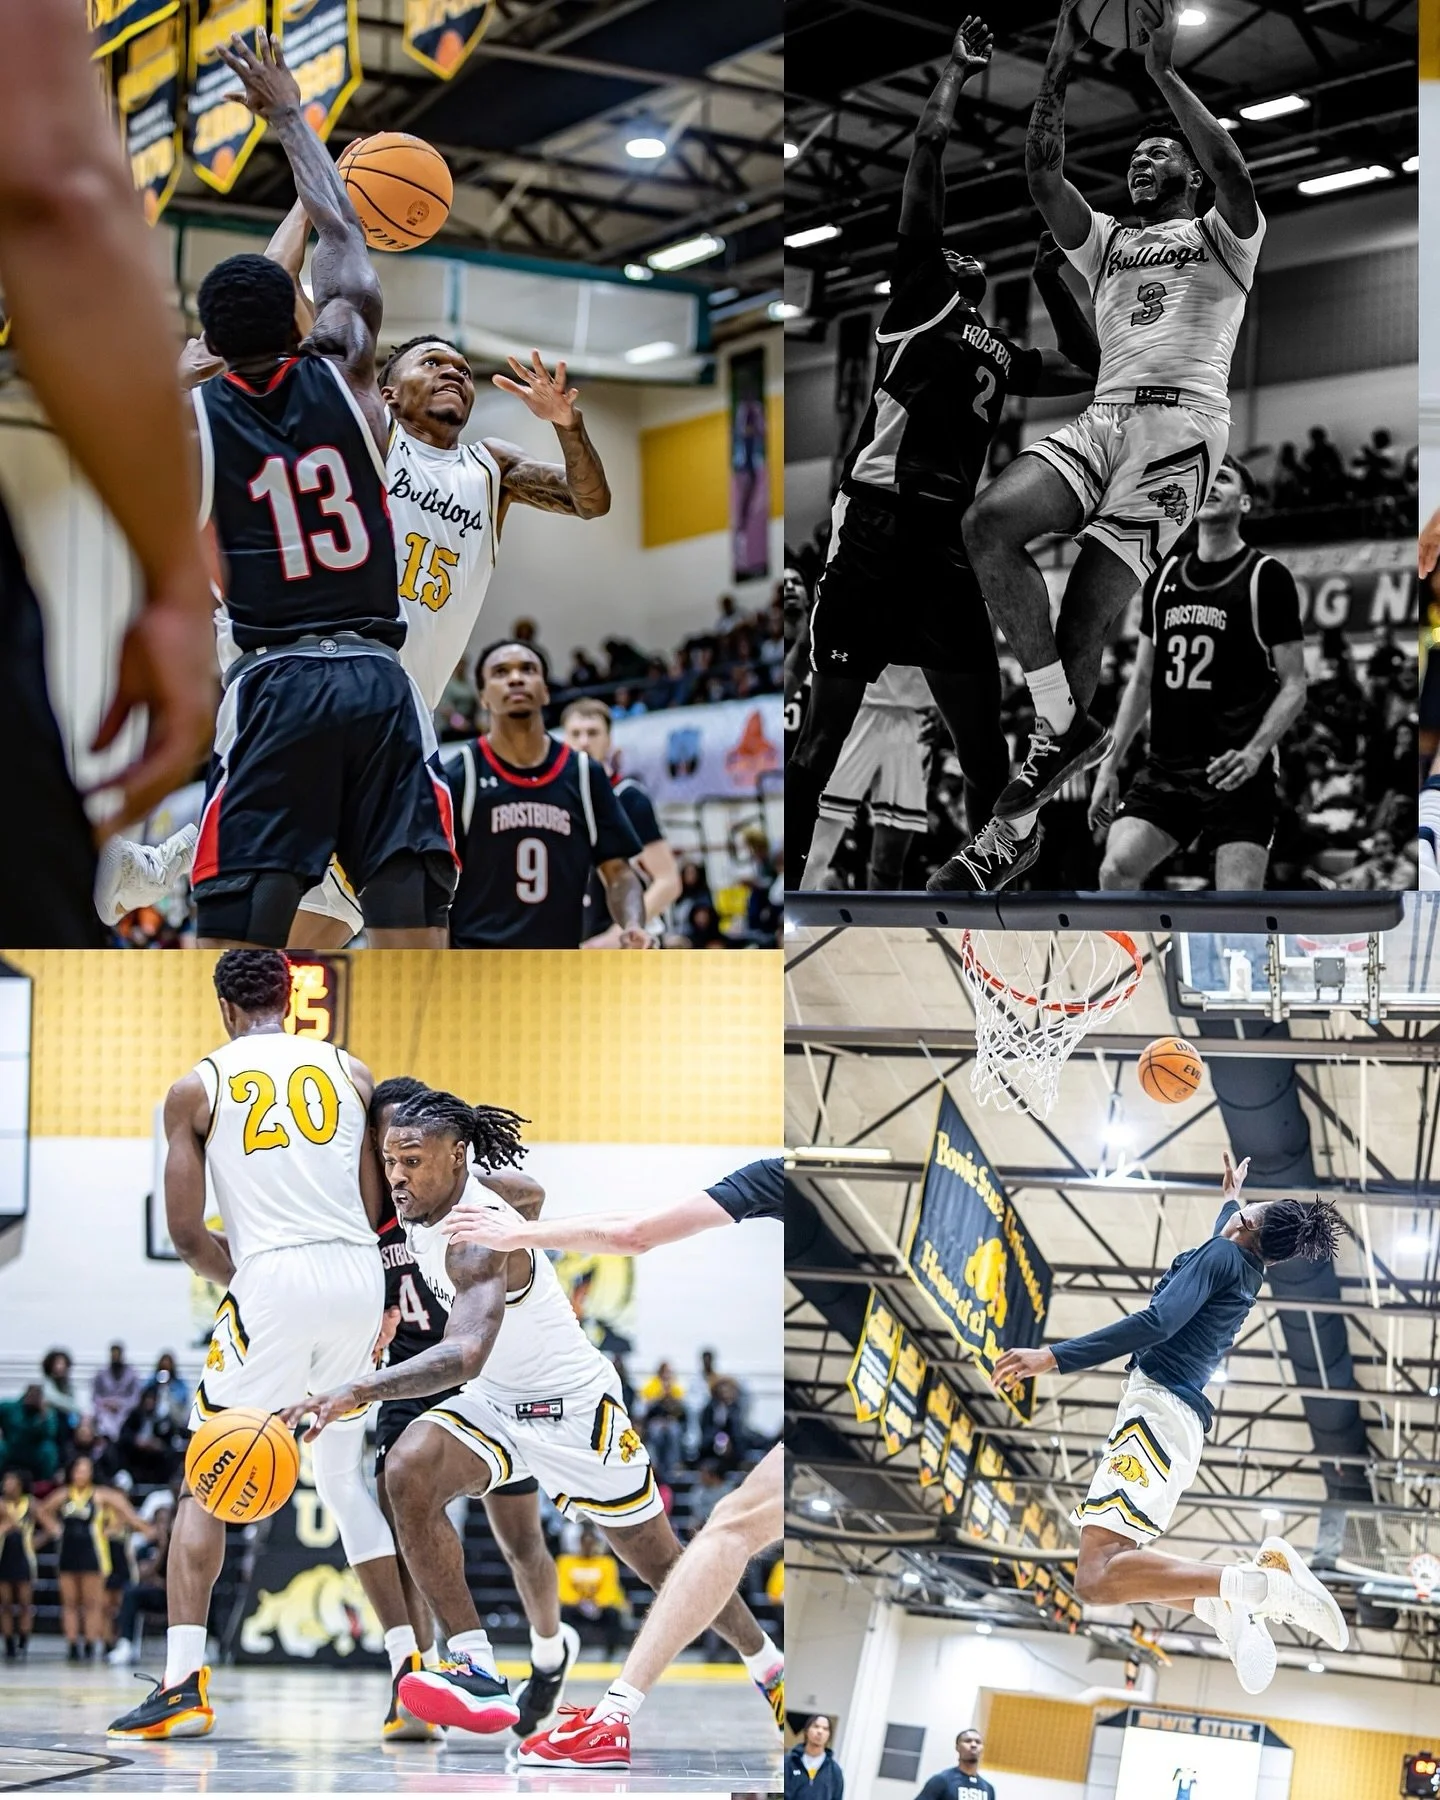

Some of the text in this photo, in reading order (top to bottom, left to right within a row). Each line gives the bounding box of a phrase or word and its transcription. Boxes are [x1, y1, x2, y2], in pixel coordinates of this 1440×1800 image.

[1107, 245, 1210, 279] Bulldogs
[1130, 281, 1169, 327] 3
[972, 365, 996, 423] 2
[248, 444, 371, 582] 13
[388, 467, 483, 538] Bulldogs
[397, 531, 460, 612] 15
[1163, 604, 1228, 631] FROSTBURG
[1164, 634, 1215, 690] 32
[491, 801, 571, 836] FROSTBURG
[516, 837, 548, 904] 9
[228, 1064, 342, 1156] 20
[399, 1273, 431, 1331] 4
